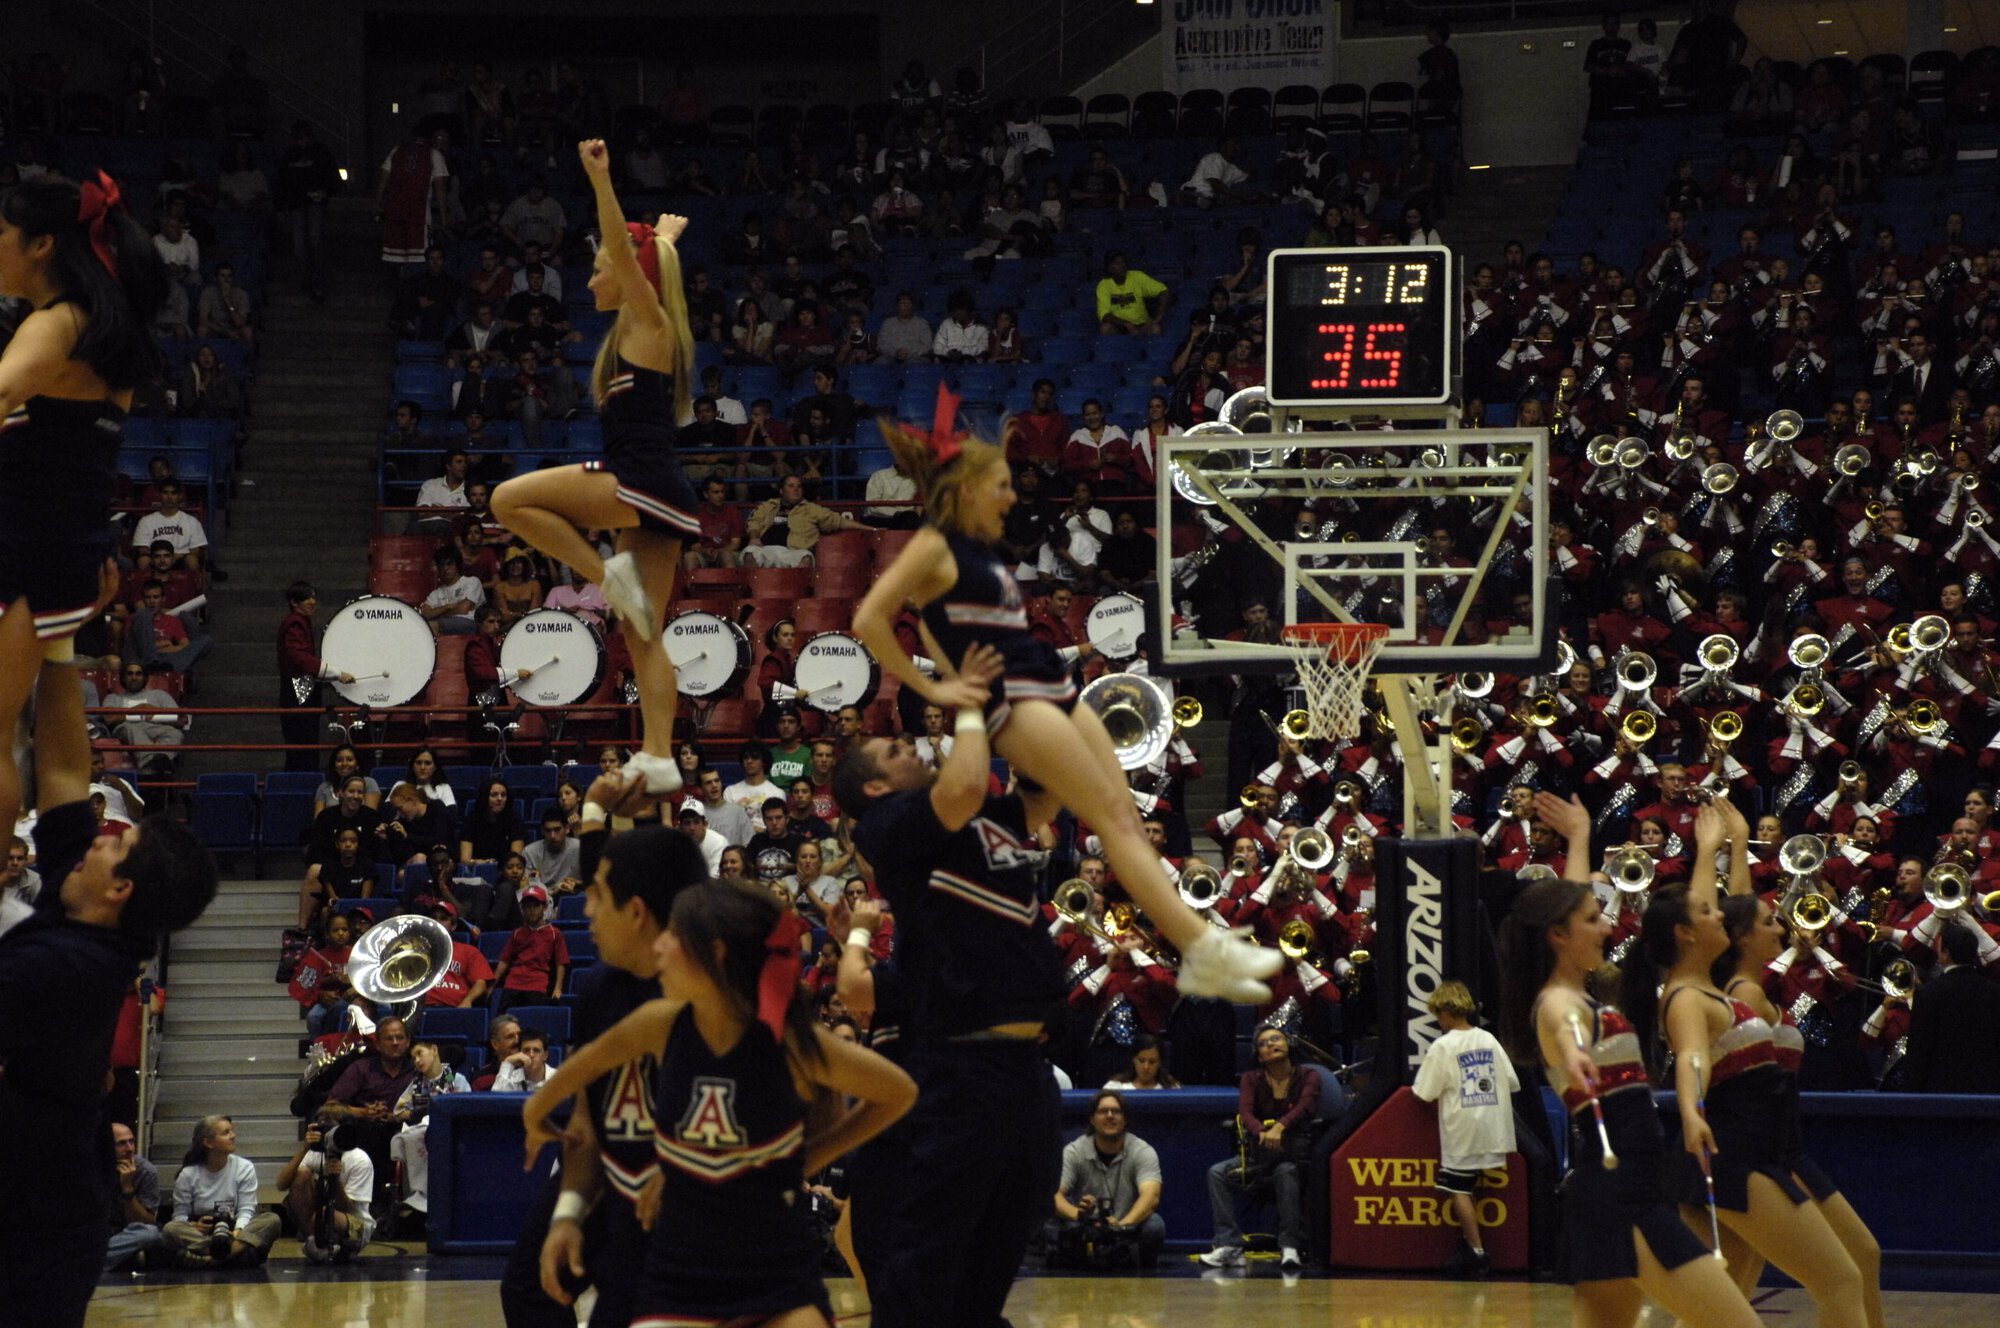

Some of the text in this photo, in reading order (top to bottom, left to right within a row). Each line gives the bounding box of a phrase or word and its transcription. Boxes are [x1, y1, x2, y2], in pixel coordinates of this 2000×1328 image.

[1311, 322, 1406, 389] 35
[152, 525, 184, 539] ARIZONA
[366, 609, 403, 620] YAMAHA
[1104, 603, 1135, 617] YAMAHA
[537, 622, 573, 633] YAMAHA
[684, 624, 720, 636] YAMAHA
[821, 646, 857, 657] YAMAHA
[970, 817, 1052, 871] A
[603, 1058, 657, 1142] A
[676, 1077, 748, 1149] A
[1347, 1157, 1510, 1189] WELS
